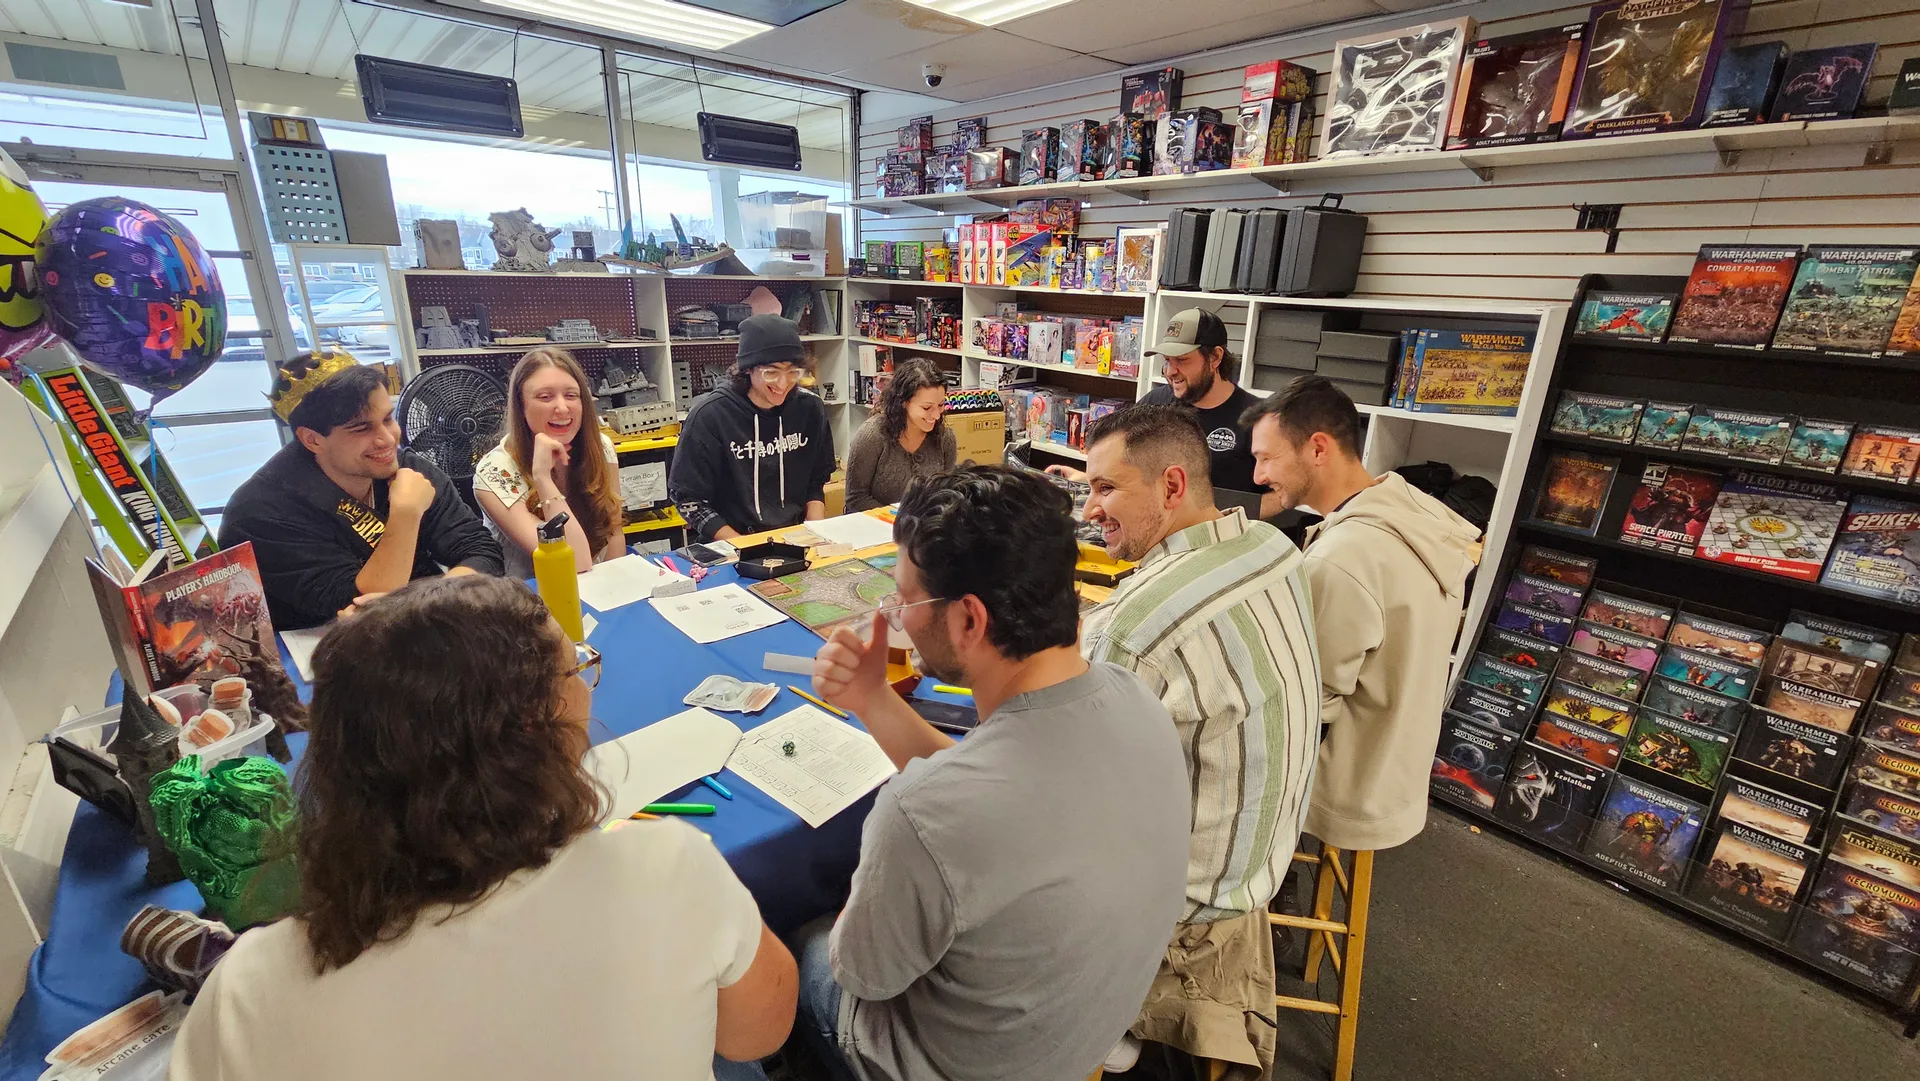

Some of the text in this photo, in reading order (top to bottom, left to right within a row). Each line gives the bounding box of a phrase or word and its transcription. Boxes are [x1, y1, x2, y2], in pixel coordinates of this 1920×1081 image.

[1596, 117, 1660, 129] DARKLANDS RISING
[1711, 250, 1784, 260] WARHAMMER
[1820, 251, 1903, 261] WARHAMMER
[1706, 264, 1778, 273] COMBAT PATROL
[1817, 266, 1897, 275] COMBAT PATROL
[1128, 279, 1148, 287] BATGIRL
[1602, 296, 1654, 305] WARHAMMER
[1460, 333, 1527, 347] WARHAMMER
[1577, 396, 1625, 408] WARHAMMER
[1713, 412, 1773, 425] WARHAMMER
[49, 375, 138, 488] Little Giant
[621, 474, 642, 482] Terrain
[642, 472, 655, 480] Box
[120, 490, 158, 521] KING
[1847, 512, 1918, 531] SPIKE!
[1629, 522, 1695, 543] SPACE PIRATES
[165, 562, 243, 603] PLAYER'S HANDBOOK
[1523, 577, 1570, 595] WARHAMMER
[1828, 572, 1854, 583] ISSUE
[1514, 605, 1561, 624] WARHAMMER
[1603, 598, 1656, 616] WARHAMMER
[1591, 627, 1644, 647] WARHAMMER
[1692, 620, 1752, 642] WARHAMMER
[1806, 619, 1875, 642] WARHAMMER
[1499, 633, 1546, 652] WARHAMMER
[1485, 660, 1532, 681] WARHAMMER
[1577, 656, 1629, 678] WARHAMMER
[1680, 652, 1740, 675] WARHAMMER
[1568, 688, 1622, 711] WARHAMMER
[1668, 684, 1728, 708] WARHAMMER
[1781, 681, 1851, 709] WARHAMMER
[1555, 719, 1608, 744] WARHAMMER
[1655, 716, 1715, 741] WARHAMMER
[1766, 715, 1838, 745] WARHAMMER
[1553, 770, 1593, 792] Leviathan
[1629, 784, 1689, 812] WARHAMMER
[1737, 784, 1809, 818] WARHAMMER
[1732, 825, 1805, 860] WARHAMMER
[1595, 852, 1668, 888] ADEPTUS CUSTODES
[1846, 875, 1917, 908] NECROMUNDA
